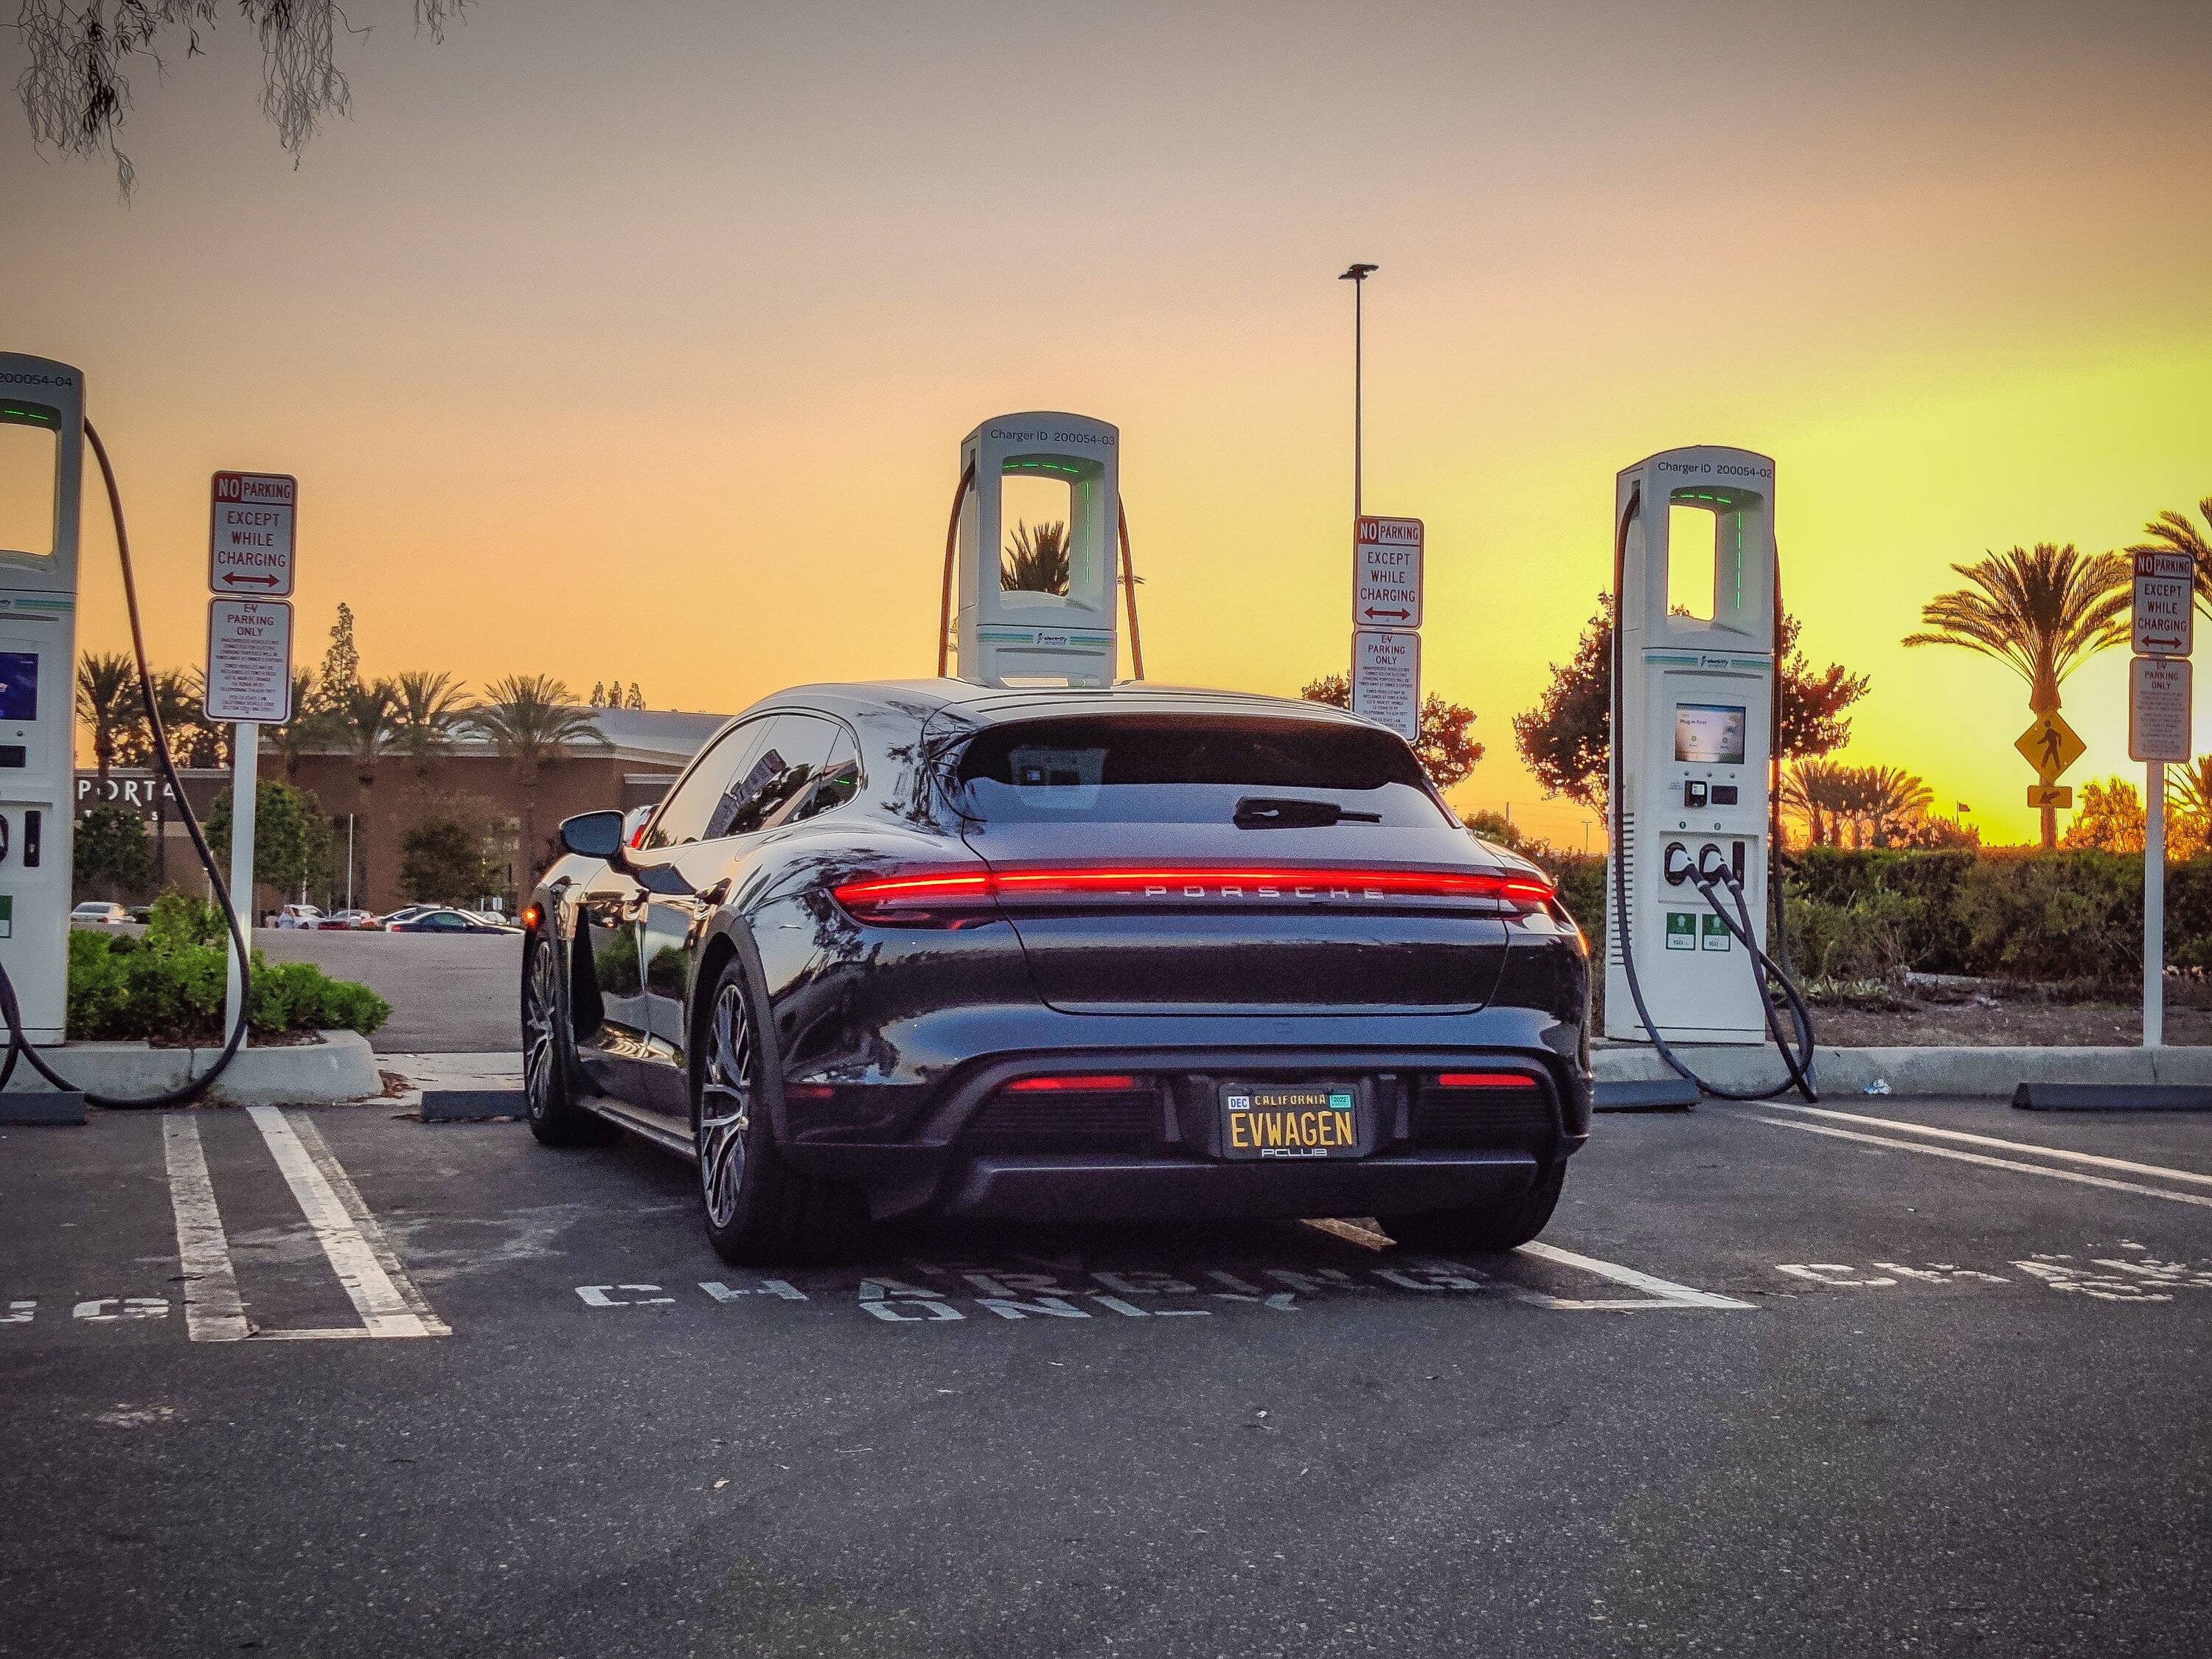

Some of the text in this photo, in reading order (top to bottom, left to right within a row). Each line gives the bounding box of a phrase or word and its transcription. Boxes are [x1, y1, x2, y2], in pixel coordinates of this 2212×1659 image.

[990, 430, 1115, 445] Charger ID 200054-03
[1658, 462, 1773, 479] Charger ID 200054-02
[218, 478, 291, 499] NO PARKING
[227, 510, 279, 526] EXCEPT
[232, 531, 274, 546] WHILE
[1360, 522, 1419, 540] NO PARKING
[218, 550, 286, 568] CHARGING
[1368, 552, 1411, 566] EXCEPT
[2138, 556, 2190, 573] NO PARKING
[1371, 569, 1405, 584] WHILE
[1360, 588, 1416, 602] CHARGING
[2144, 582, 2182, 597] EXCEPT
[243, 603, 258, 613] EV
[2147, 600, 2178, 614] WHILE
[227, 614, 274, 626] PARKING
[2138, 618, 2187, 633] CHARGING
[237, 626, 264, 637] ONLY
[1381, 635, 1393, 644] EV
[1368, 644, 1406, 655] PARKING
[1375, 655, 1397, 664] ONLY
[2144, 670, 2179, 681] PARKING
[2152, 681, 2171, 690] ONLY
[1144, 886, 1384, 900] PORSCHE
[1231, 1098, 1248, 1109] DEC
[1254, 1093, 1326, 1105] CALIFORNIA
[1231, 1110, 1353, 1147] EVWAGEN
[1261, 1148, 1327, 1157] PCLUB
[859, 1293, 1301, 1322] ONLY
